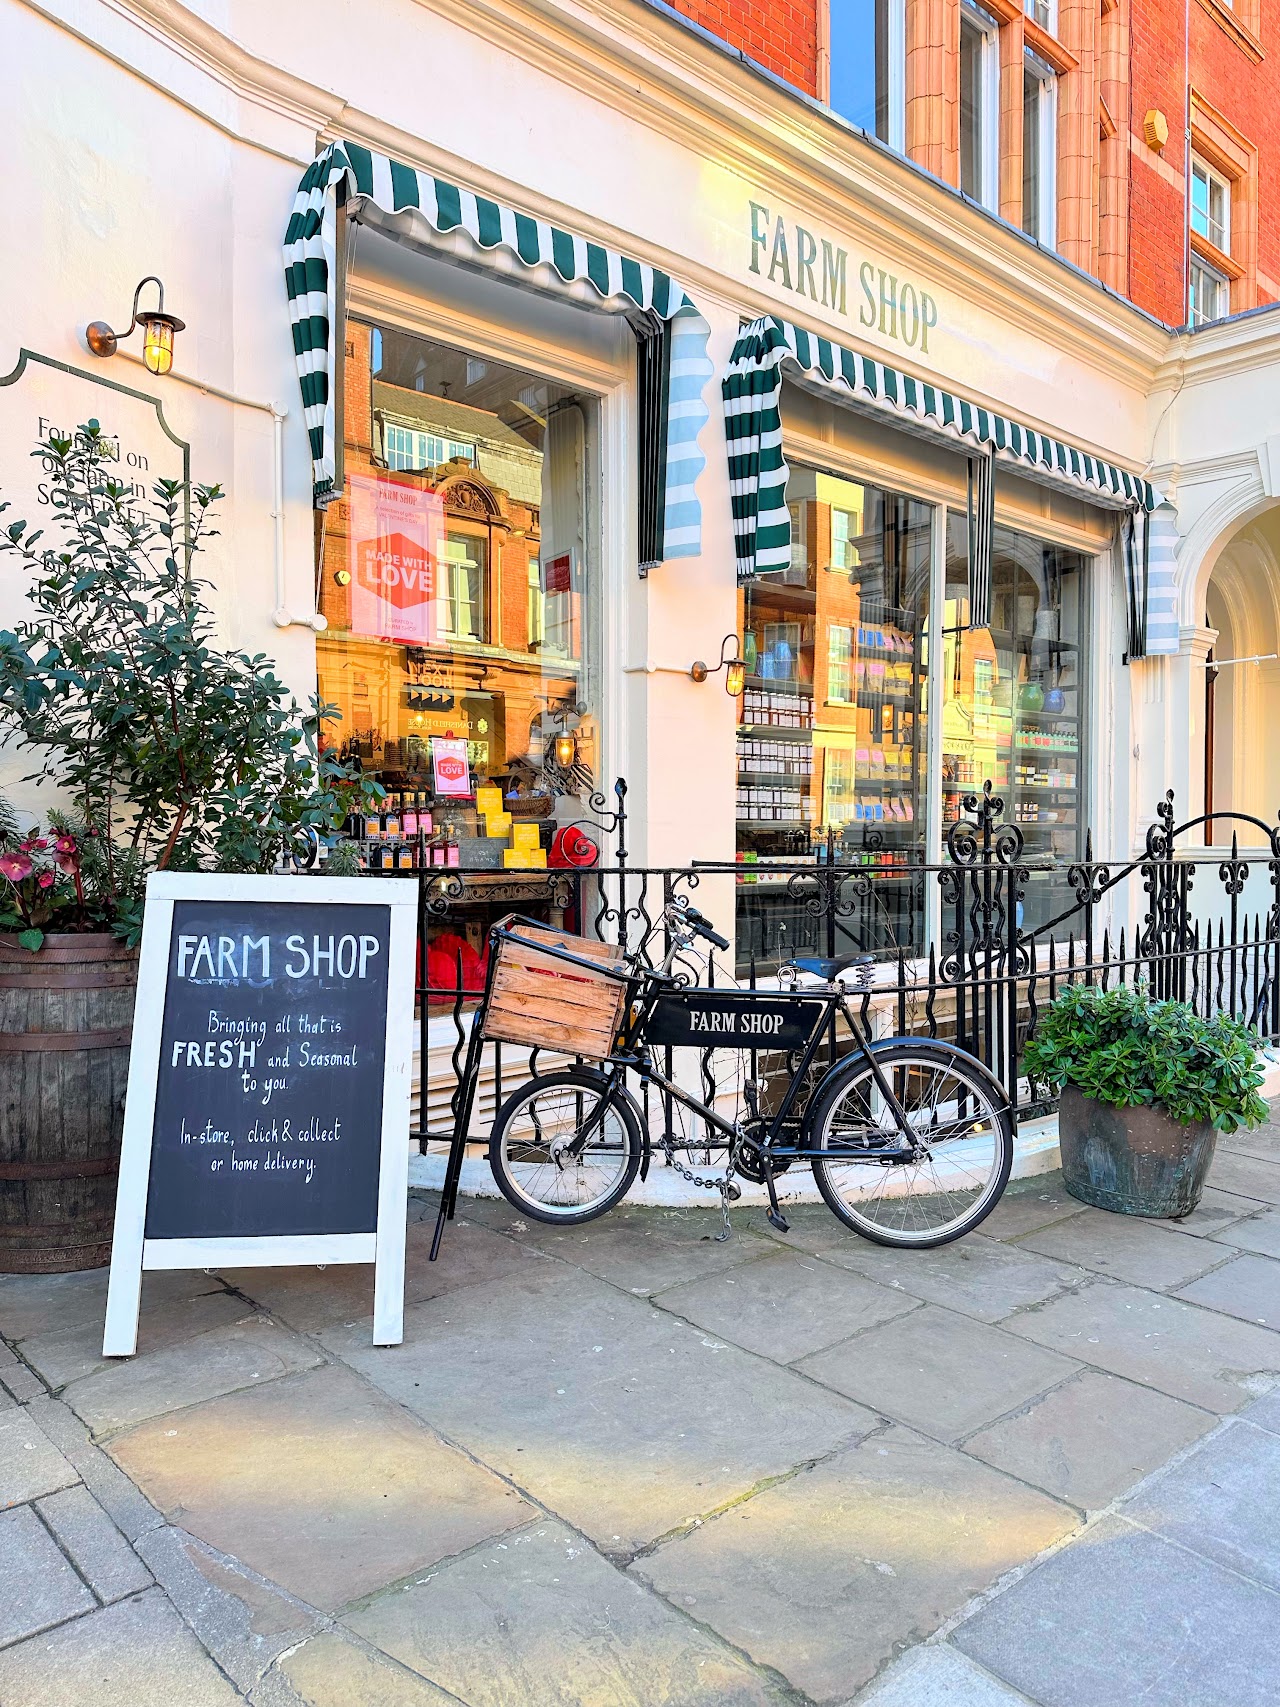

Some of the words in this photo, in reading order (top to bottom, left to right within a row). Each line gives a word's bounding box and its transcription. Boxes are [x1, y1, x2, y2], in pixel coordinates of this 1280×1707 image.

[748, 199, 849, 317] FARM
[859, 261, 938, 355] SHOP
[126, 452, 149, 471] on
[130, 476, 146, 499] in
[379, 487, 398, 502] FARM
[400, 492, 418, 506] SHOP
[365, 549, 401, 565] MADE
[402, 556, 432, 571] WITH
[366, 561, 434, 593] LOVE
[408, 660, 453, 676] NEXT
[440, 766, 463, 775] LOVE
[176, 934, 271, 979] FARM
[285, 933, 380, 979] SHOP
[207, 1009, 267, 1047] Bringing
[275, 1014, 291, 1034] all
[298, 1015, 326, 1034] that
[330, 1018, 342, 1034] is
[689, 1010, 737, 1033] FARM
[740, 1013, 784, 1035] SHOP
[171, 1040, 257, 1069] FRESH
[268, 1046, 290, 1068] and
[299, 1041, 359, 1067] Seasonal
[241, 1068, 257, 1093] to
[262, 1077, 290, 1105] you.
[180, 1117, 235, 1146] In-store,
[248, 1118, 279, 1143] click
[281, 1119, 294, 1142] &
[298, 1117, 342, 1142] collect
[210, 1158, 224, 1172] or
[231, 1150, 259, 1172] home
[264, 1151, 317, 1184] delivery.
